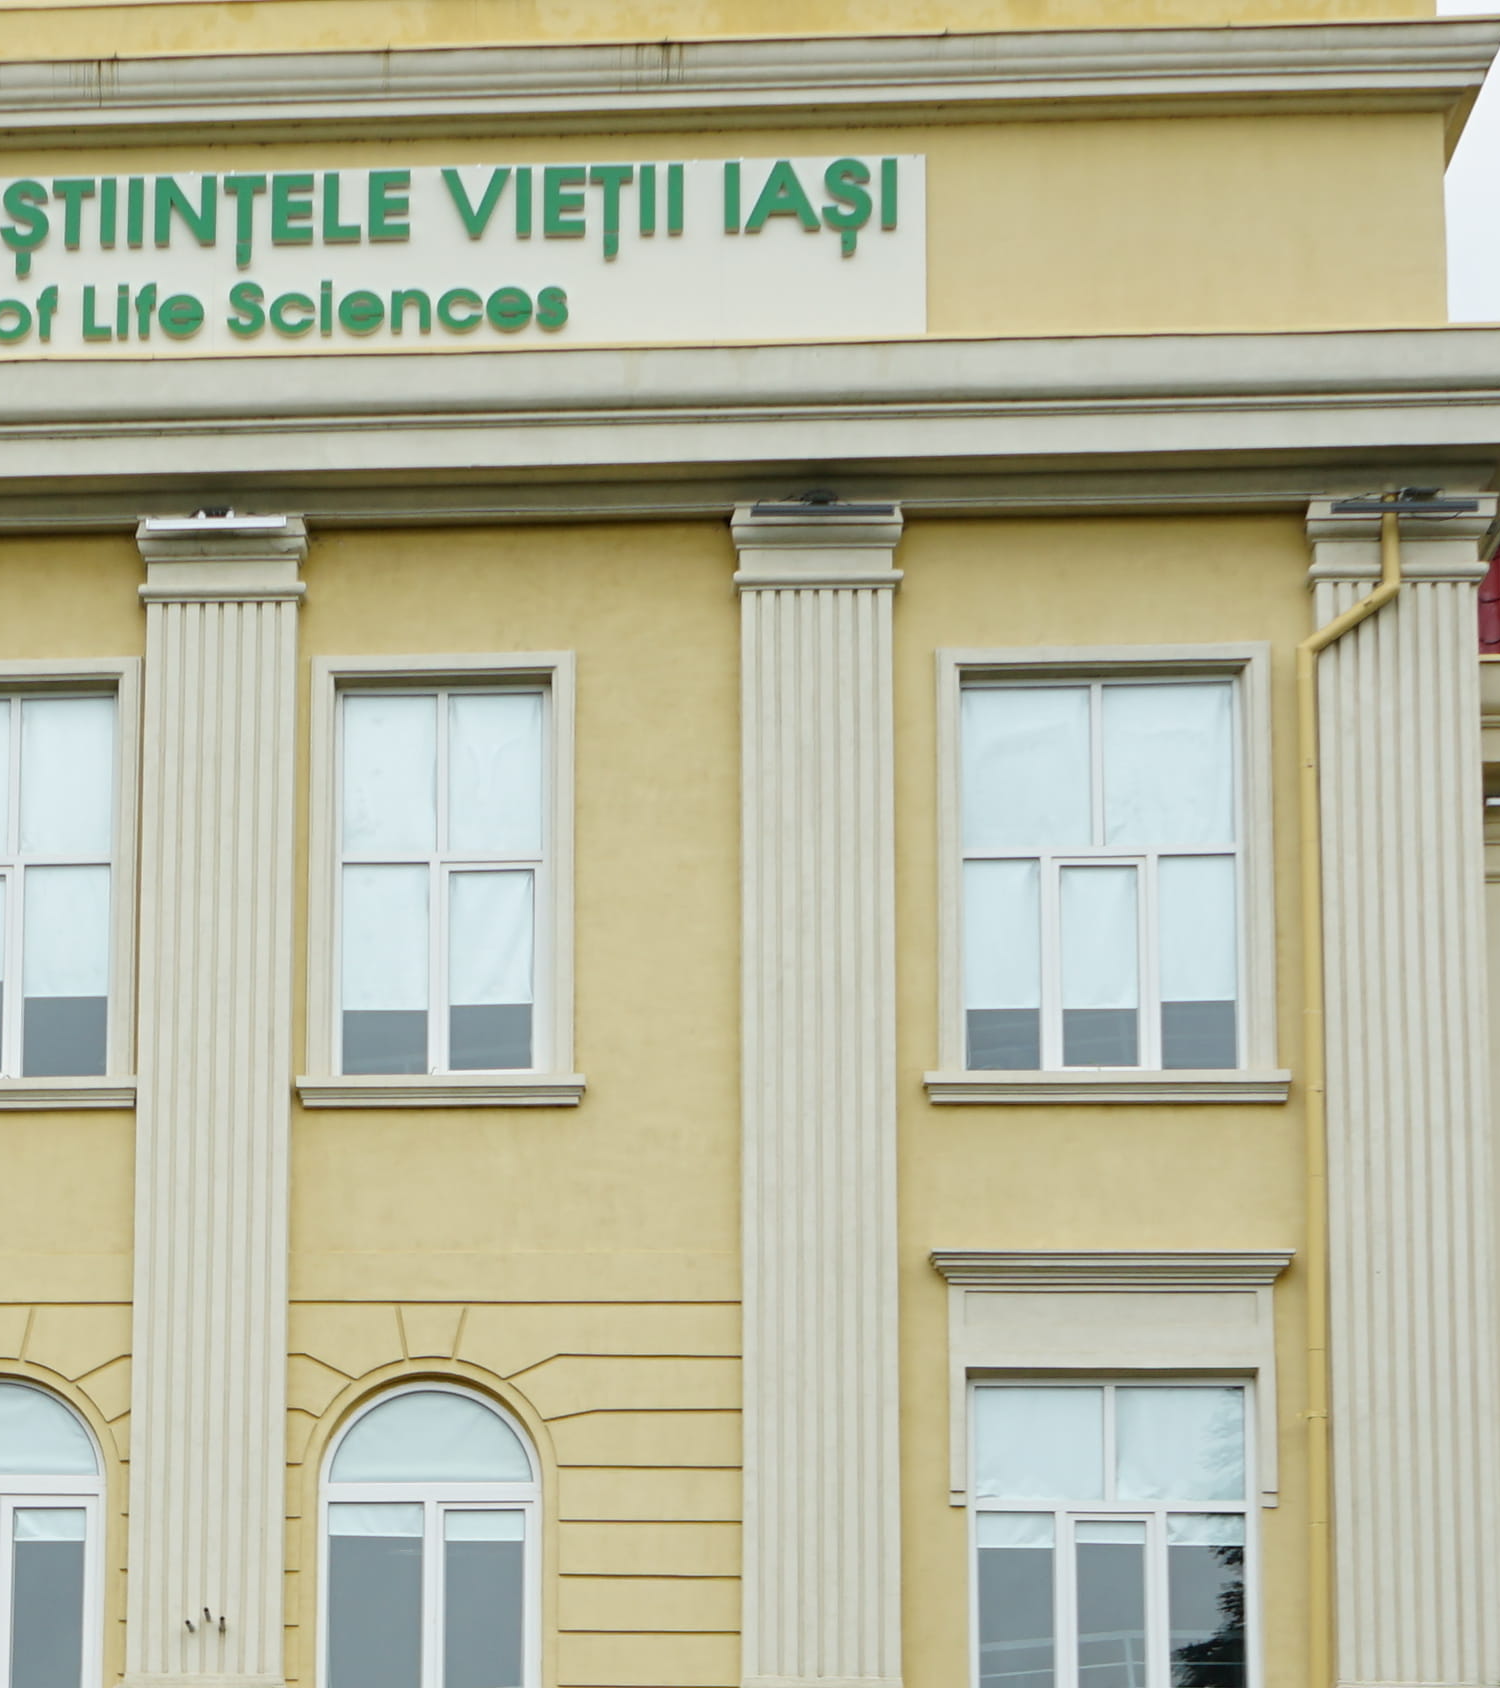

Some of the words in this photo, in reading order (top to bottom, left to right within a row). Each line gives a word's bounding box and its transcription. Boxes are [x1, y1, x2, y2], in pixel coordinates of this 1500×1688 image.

[0, 168, 412, 278] ȘTIINȚELE
[441, 162, 685, 262] VIEȚII
[723, 156, 899, 259] IAȘI
[81, 281, 206, 341] Life
[227, 279, 571, 336] Sciences
